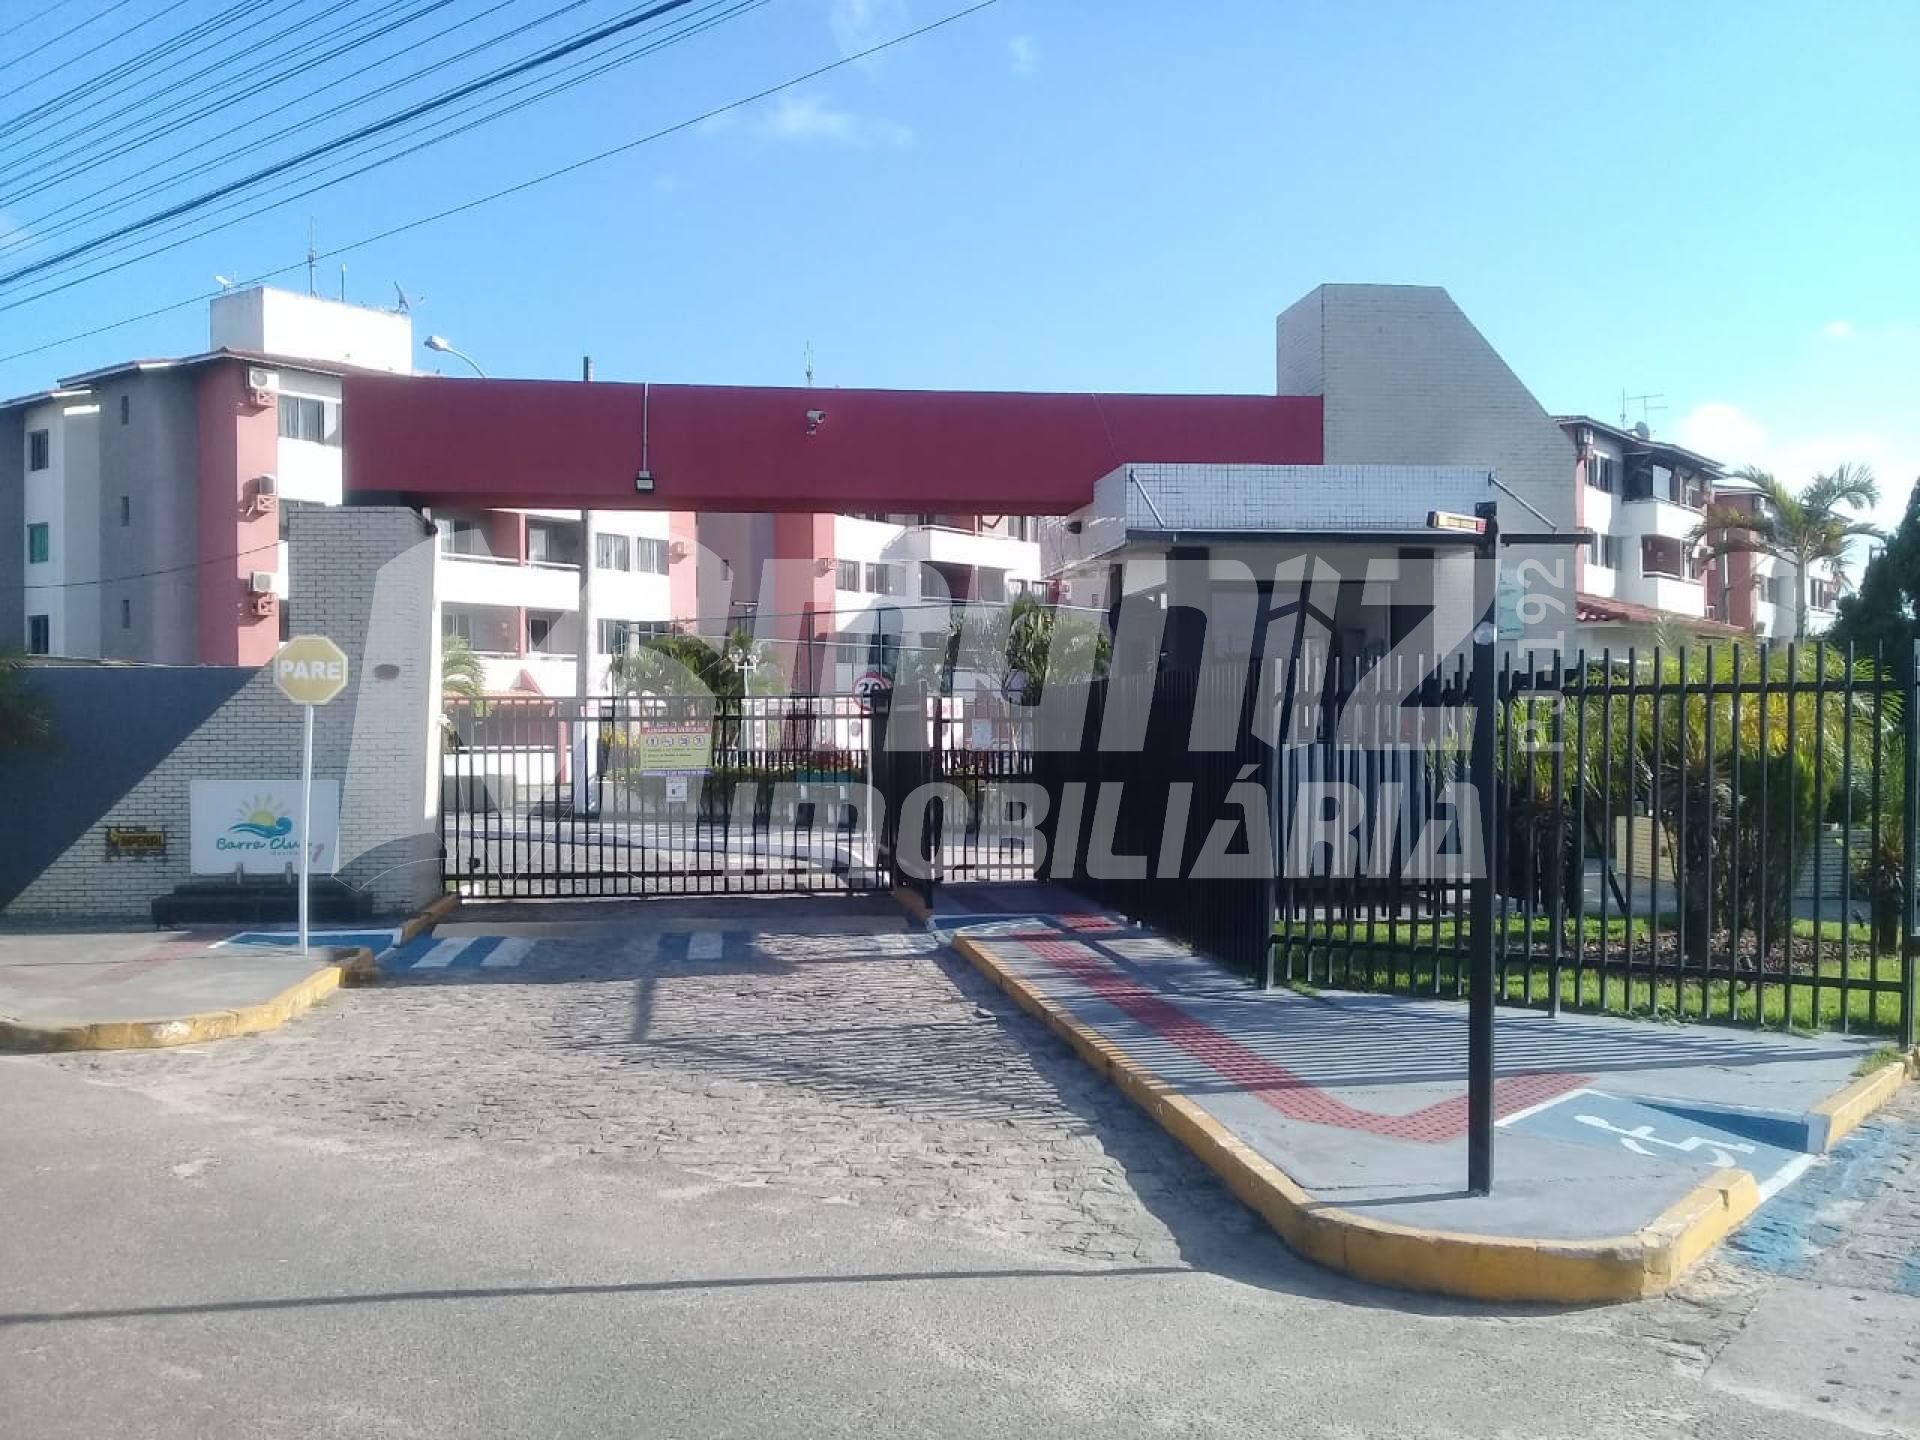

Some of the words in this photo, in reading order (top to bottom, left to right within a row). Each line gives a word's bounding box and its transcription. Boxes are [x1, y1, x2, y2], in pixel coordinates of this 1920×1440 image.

[279, 660, 342, 679] PARE
[216, 838, 266, 850] Barra
[269, 836, 313, 850] Clu
